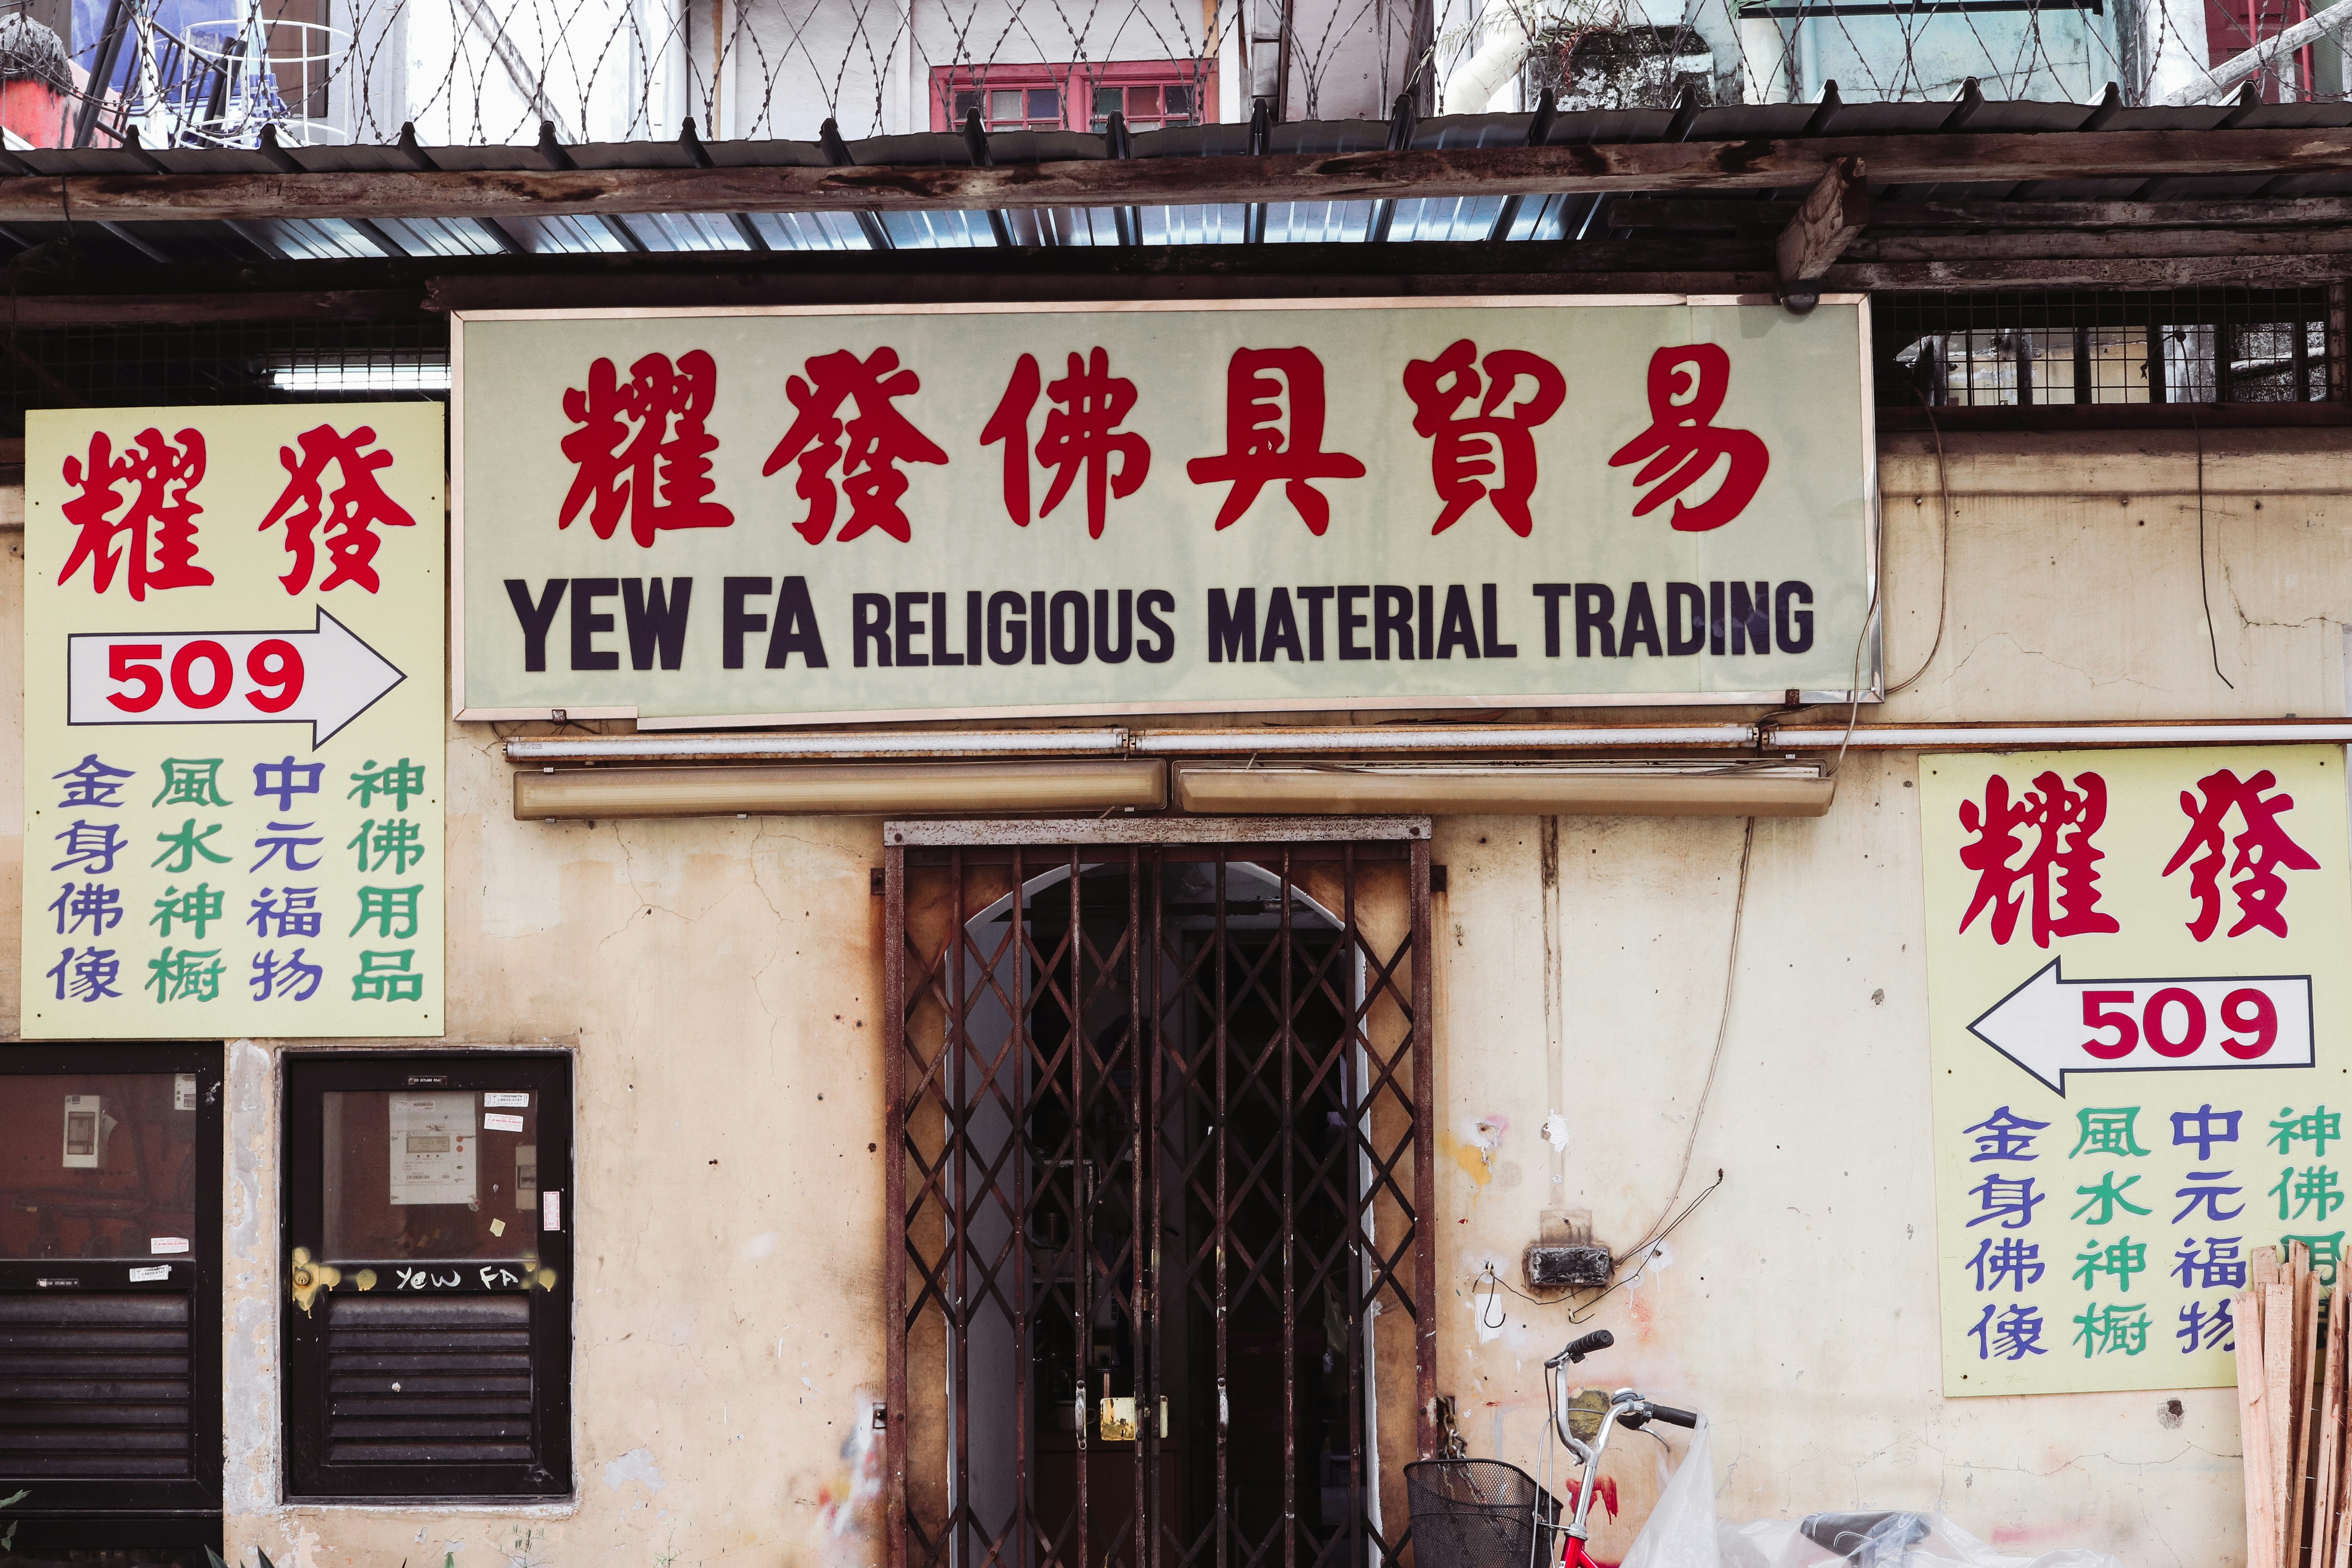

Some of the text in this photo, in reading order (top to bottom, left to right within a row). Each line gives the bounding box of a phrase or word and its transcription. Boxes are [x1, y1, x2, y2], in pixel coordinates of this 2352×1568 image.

[559, 339, 1770, 548] 耀發佛具貿易
[504, 576, 1814, 672] YEW FA RELIGIOUS MATERIAL TRADING
[106, 639, 305, 713] 509
[2082, 987, 2278, 1060] 509
[480, 1266, 518, 1289] FA
